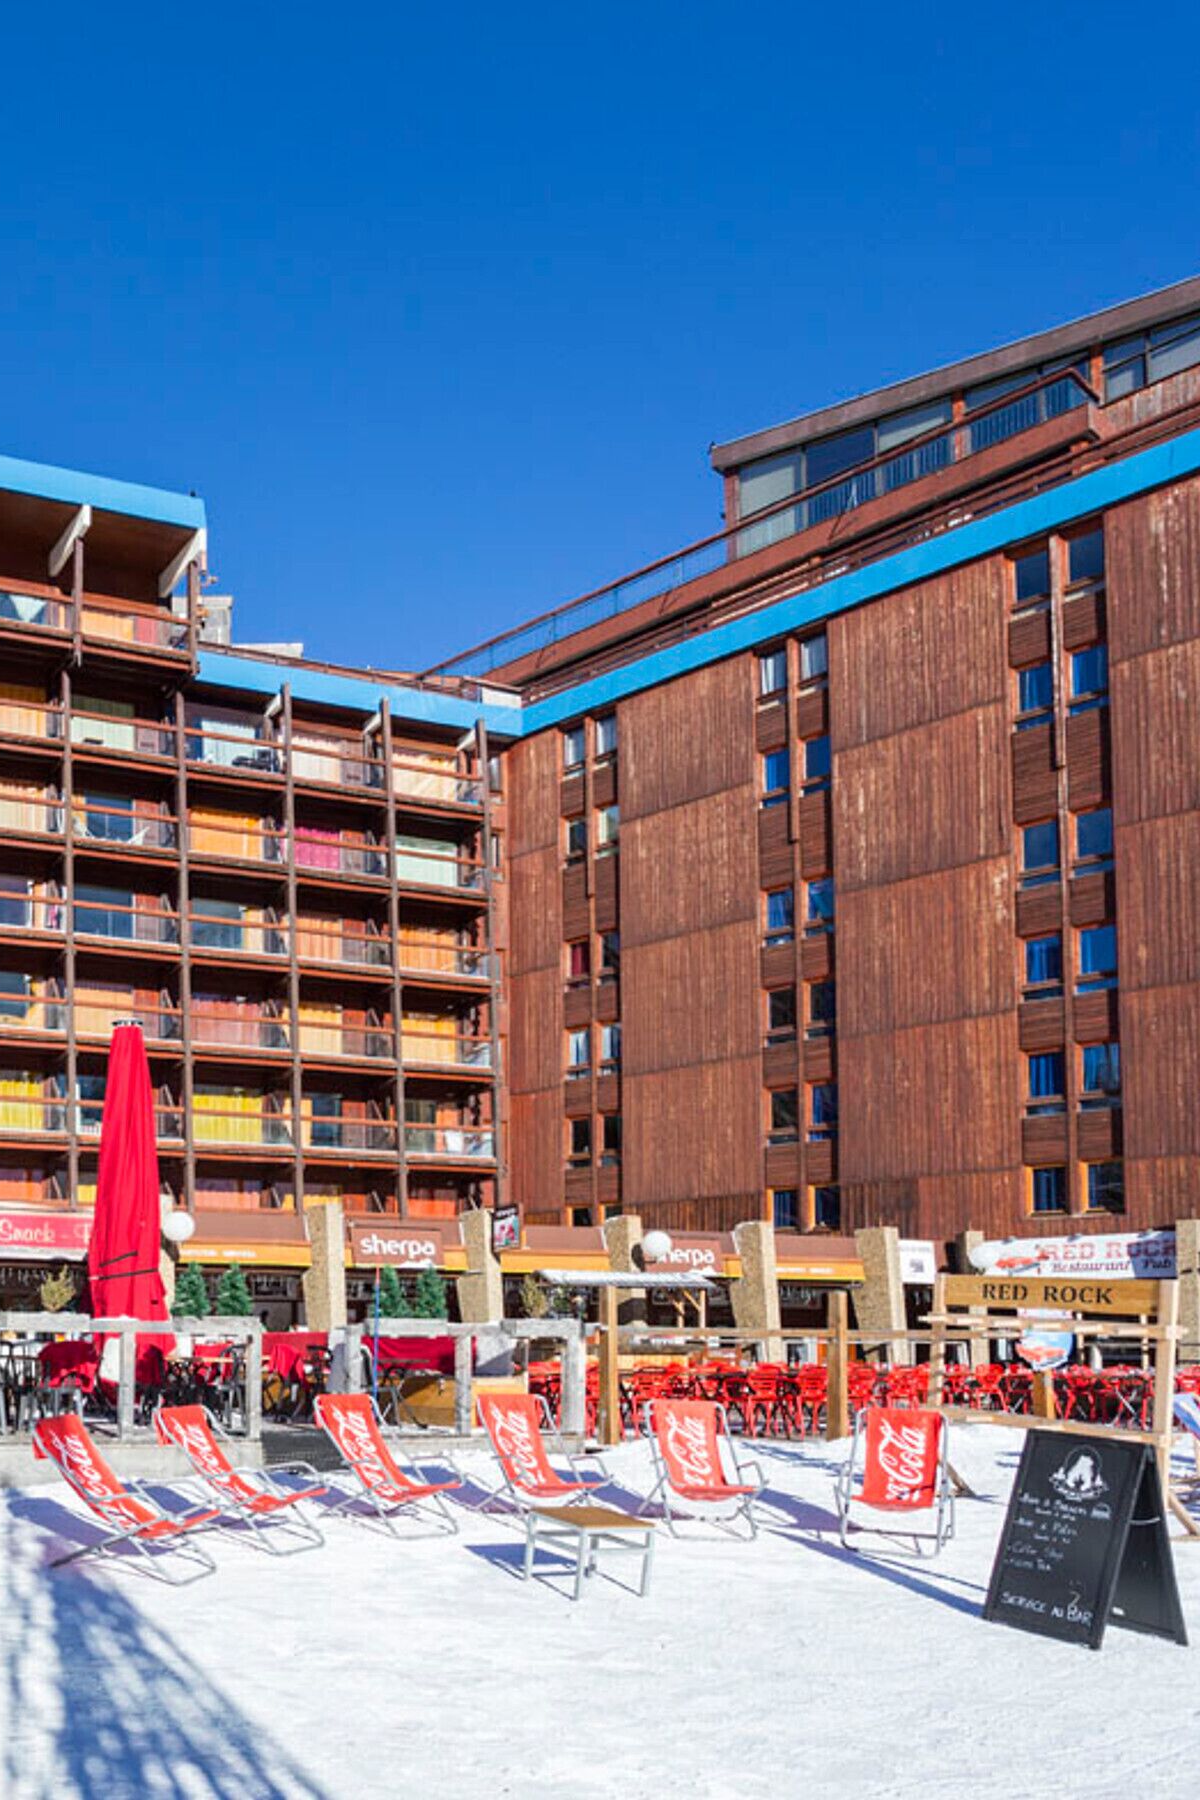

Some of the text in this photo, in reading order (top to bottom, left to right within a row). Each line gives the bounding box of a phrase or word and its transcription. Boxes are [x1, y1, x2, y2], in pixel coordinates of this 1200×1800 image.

[360, 1233, 436, 1259] sherpa
[1042, 1241, 1094, 1261] RED
[981, 1282, 1113, 1305] RED ROCK
